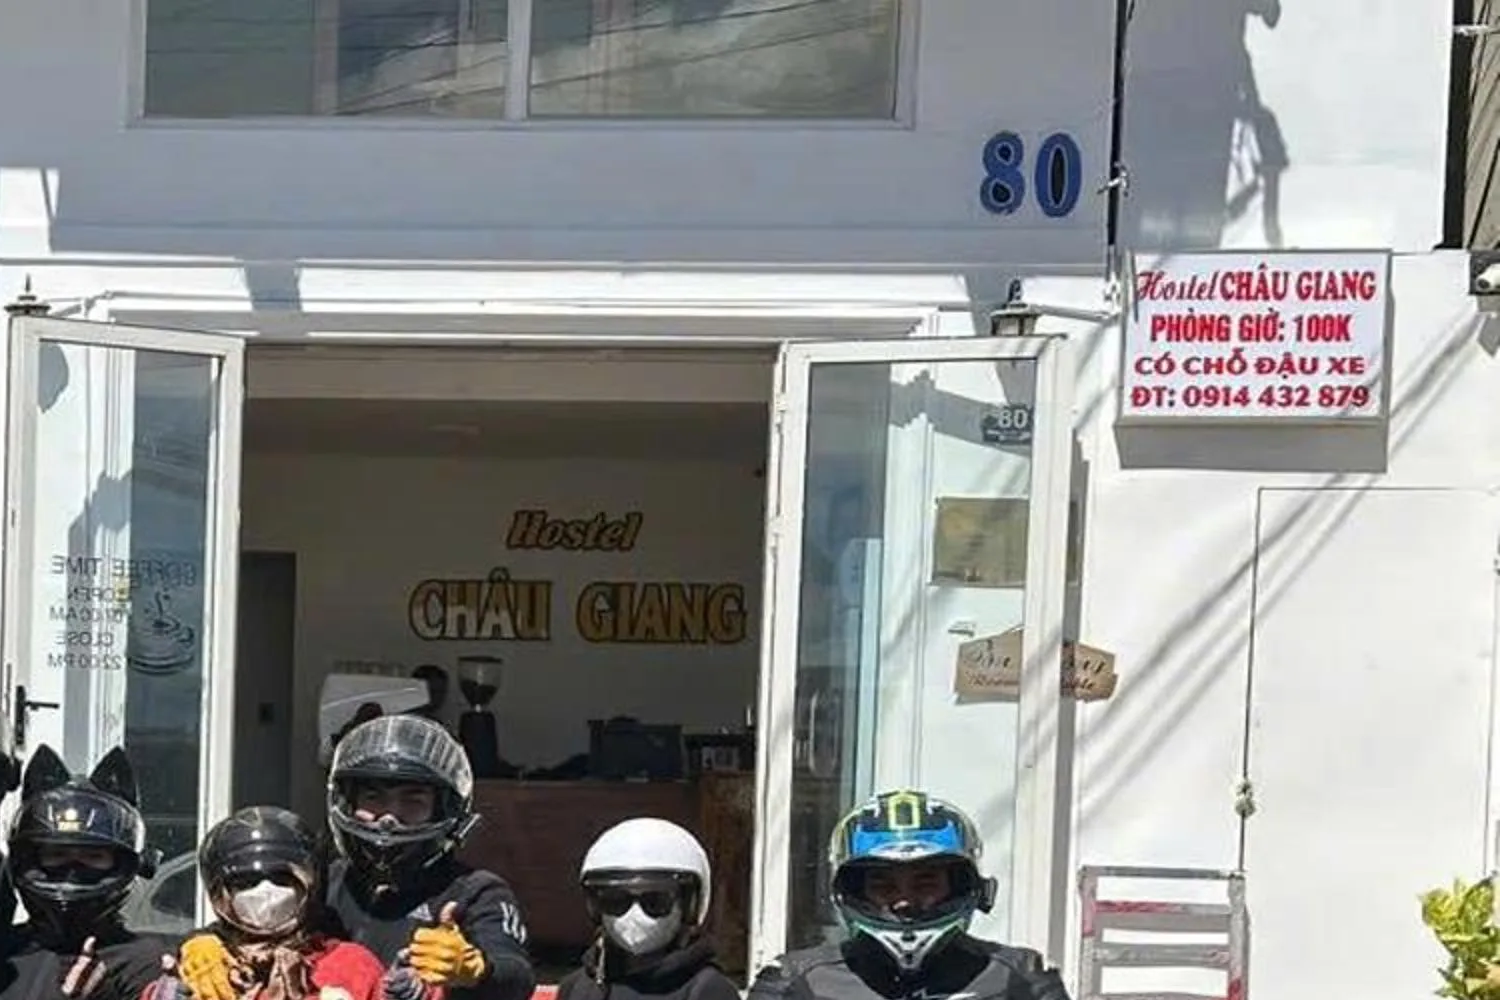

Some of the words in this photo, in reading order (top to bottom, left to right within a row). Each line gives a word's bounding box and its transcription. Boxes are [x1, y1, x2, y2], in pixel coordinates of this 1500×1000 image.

[980, 131, 1082, 217] 80
[1136, 270, 1219, 300] Hostel
[1220, 262, 1289, 300] CHÂU
[1296, 271, 1376, 300] GIANG
[1151, 308, 1231, 342] PHÒNG
[1238, 307, 1285, 342] GIỜ:
[1294, 314, 1352, 342] 100K
[1135, 352, 1175, 375] CÓ
[1182, 348, 1247, 375] CHỖ
[1254, 352, 1319, 380] ĐẬU
[1326, 357, 1365, 375] XE
[1130, 386, 1175, 408] ĐT:
[1182, 386, 1251, 408] 0914
[1258, 386, 1310, 408] 432
[1318, 386, 1370, 408] 879
[999, 407, 1029, 429] 80
[506, 510, 643, 550] Hostel
[409, 566, 552, 641] CHÂU
[576, 581, 747, 644] GIANG
